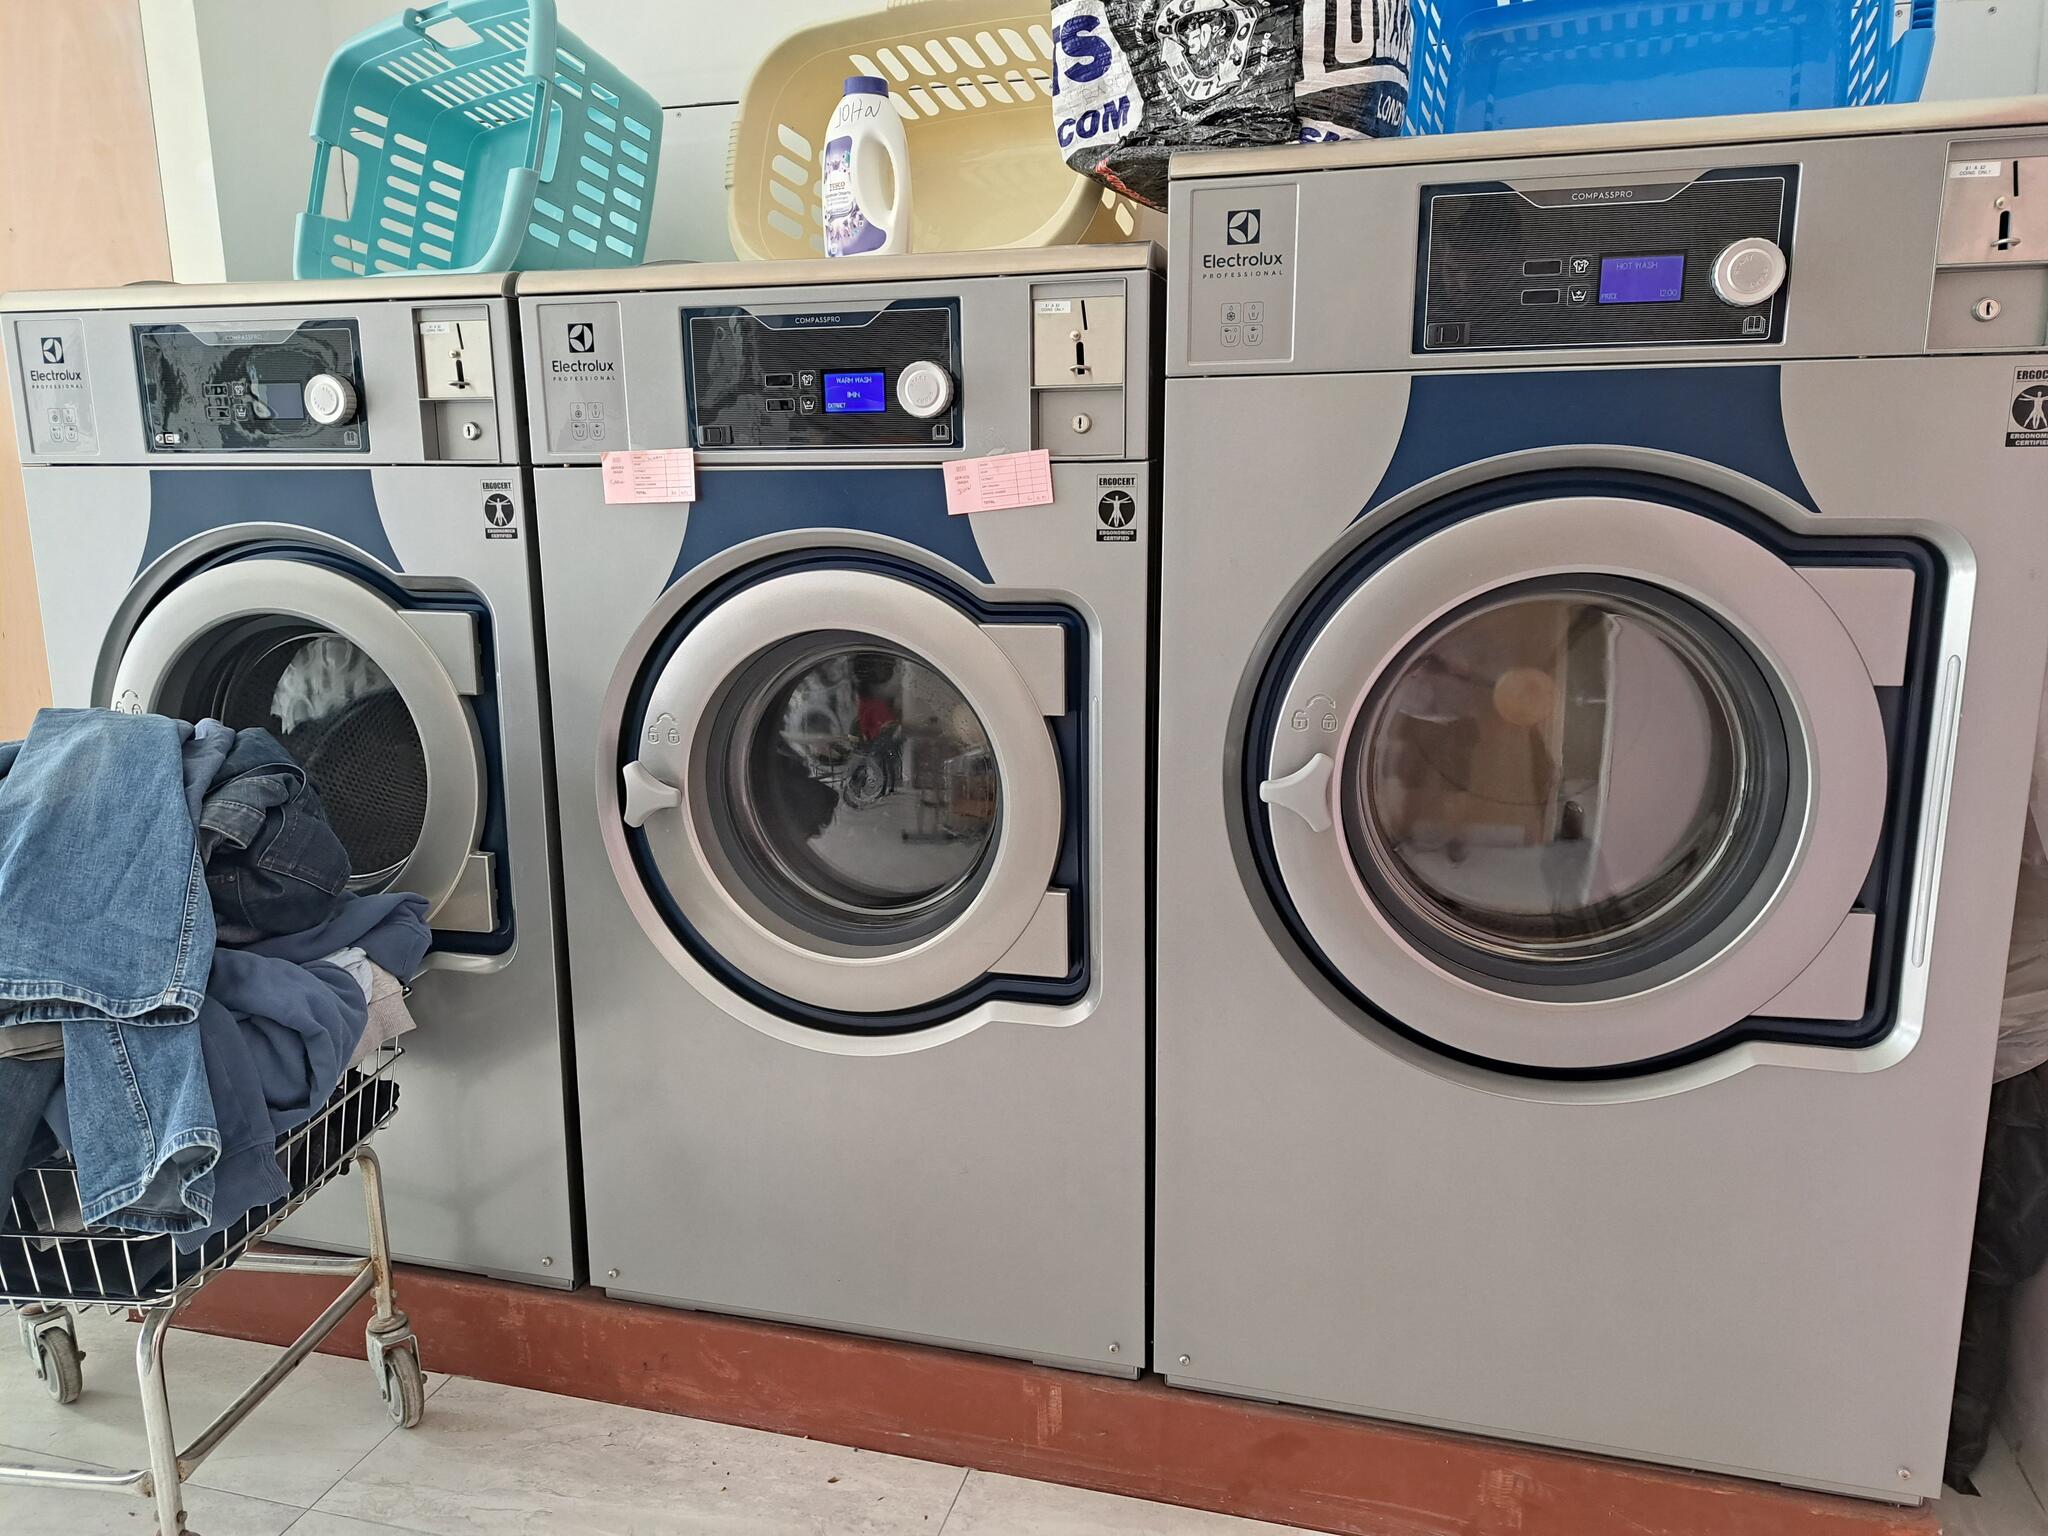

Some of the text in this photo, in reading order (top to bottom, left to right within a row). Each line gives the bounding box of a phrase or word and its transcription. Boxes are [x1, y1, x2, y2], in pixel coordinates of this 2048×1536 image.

[1571, 190, 1633, 201] COMPASSPRO
[1203, 251, 1283, 269] Electrolux
[1616, 261, 1658, 270] HOT WASH
[1202, 270, 1283, 279] PROFESSIONAL
[794, 315, 841, 324] COMPASSPRO
[552, 359, 615, 373] Electrolux
[30, 370, 82, 382] Electrolux
[836, 376, 872, 384] WARM WASH
[482, 481, 512, 490] ERGOCERT
[1099, 477, 1136, 486] ERGOCERT
